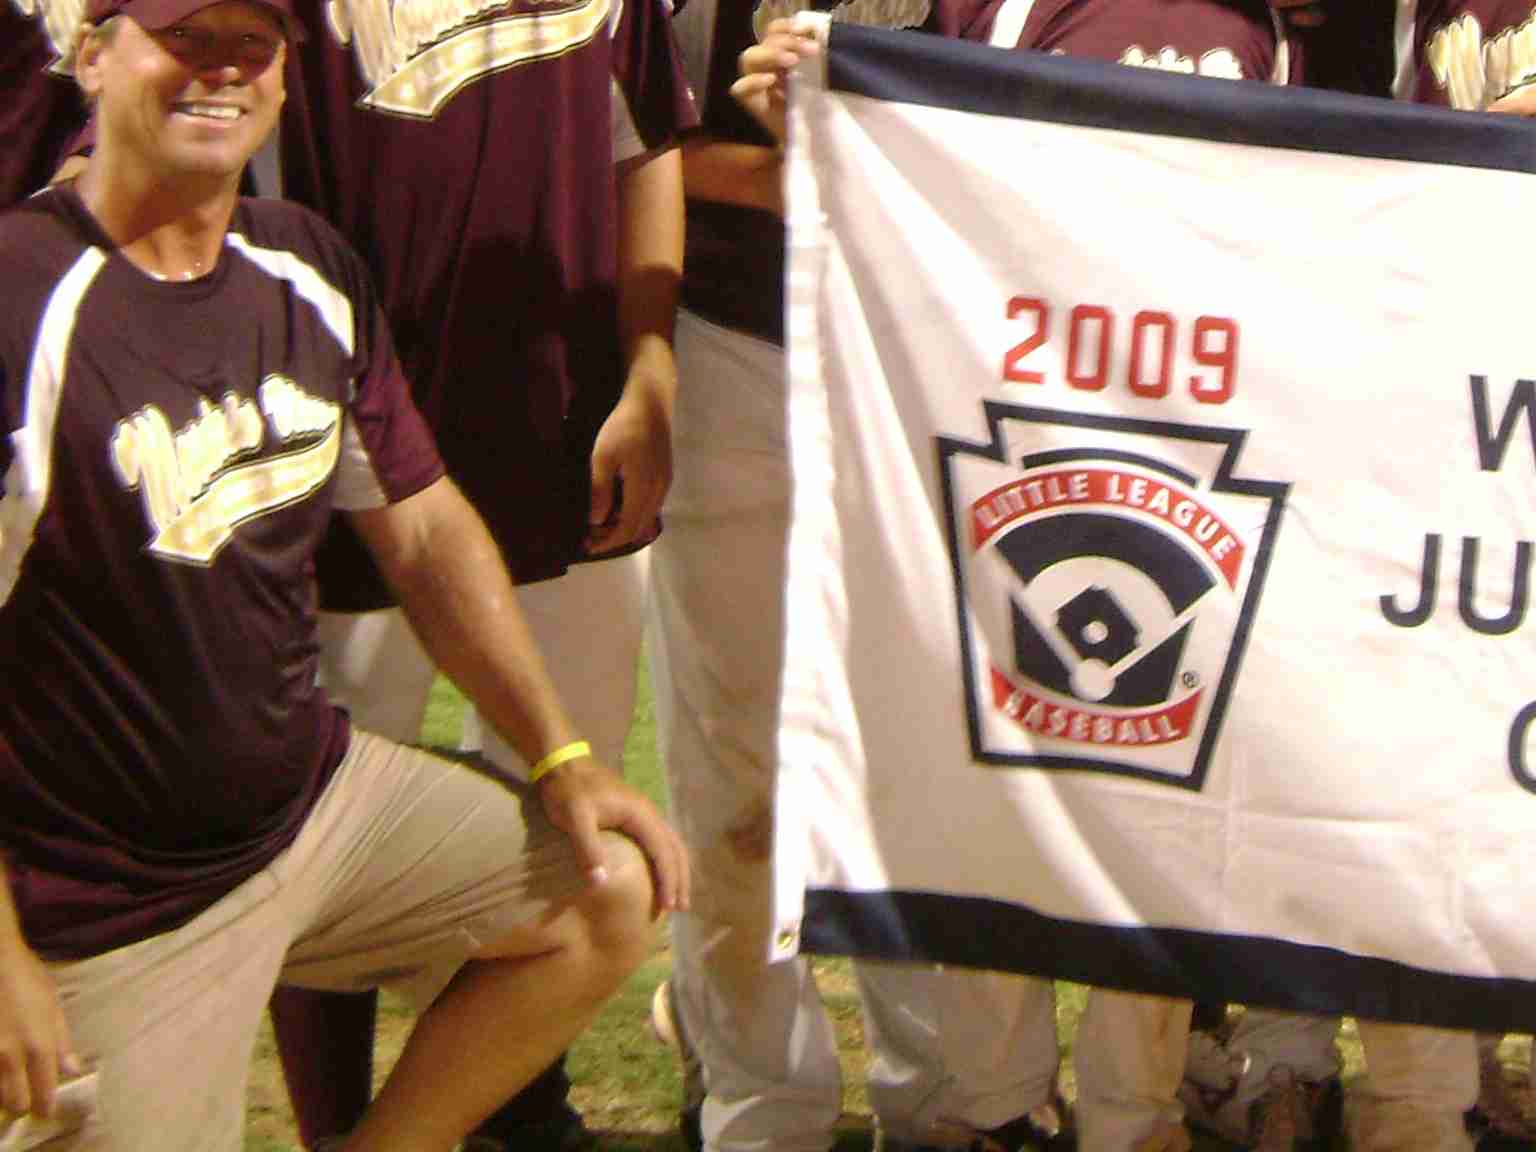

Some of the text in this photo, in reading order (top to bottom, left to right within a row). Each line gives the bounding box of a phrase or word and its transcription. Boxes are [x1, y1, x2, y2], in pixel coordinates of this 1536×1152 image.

[1001, 295, 1240, 406] 2009
[975, 472, 1237, 561] LITTLE LEAGUE
[1005, 689, 1182, 744] BASEBALL
